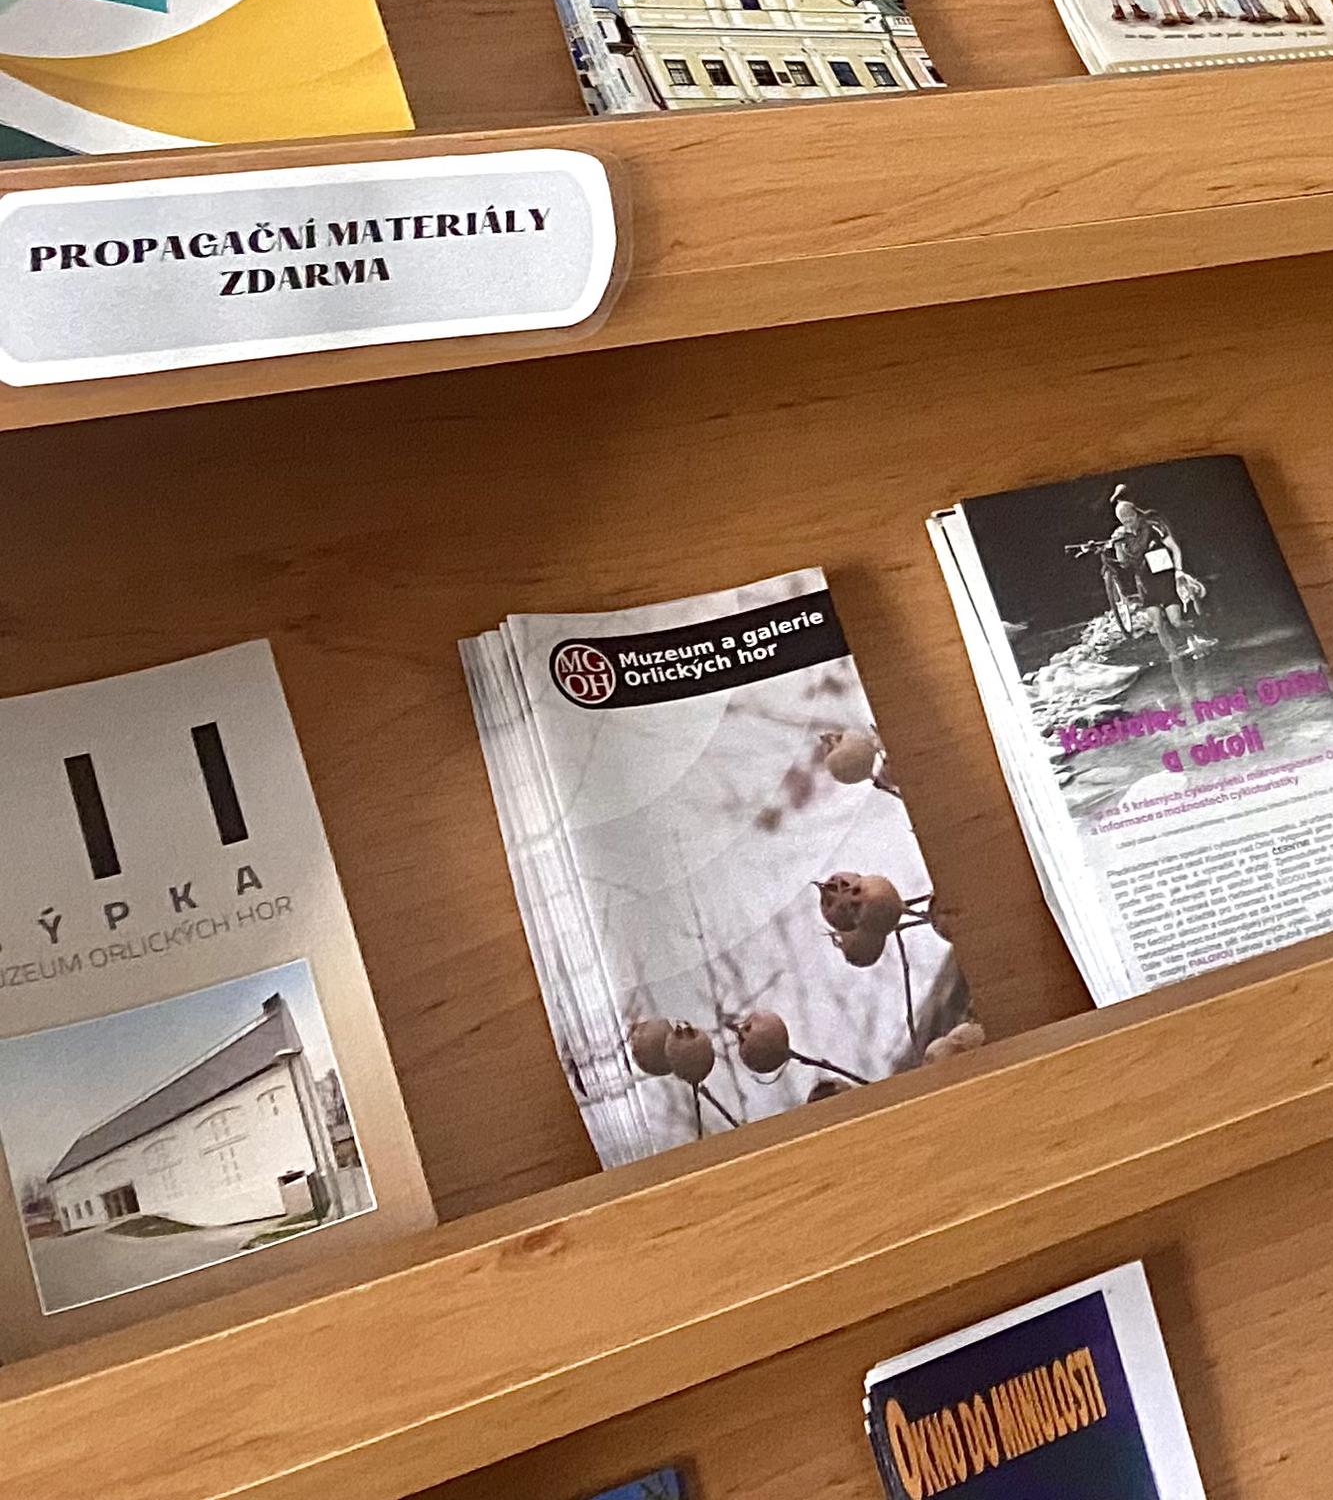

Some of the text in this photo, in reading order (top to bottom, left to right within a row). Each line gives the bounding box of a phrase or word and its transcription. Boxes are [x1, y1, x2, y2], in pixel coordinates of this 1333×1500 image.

[29, 205, 551, 273] PROPAGAČNÍ MATERIÁLY
[218, 256, 391, 297] ZDARMA
[618, 610, 825, 669] Muzeum a galerie
[624, 642, 778, 687] Orlických hor
[1059, 706, 1187, 755] Kostelec
[1191, 687, 1248, 723] nad
[88, 915, 230, 969] ORLICKÝCH
[237, 895, 294, 928] HOR
